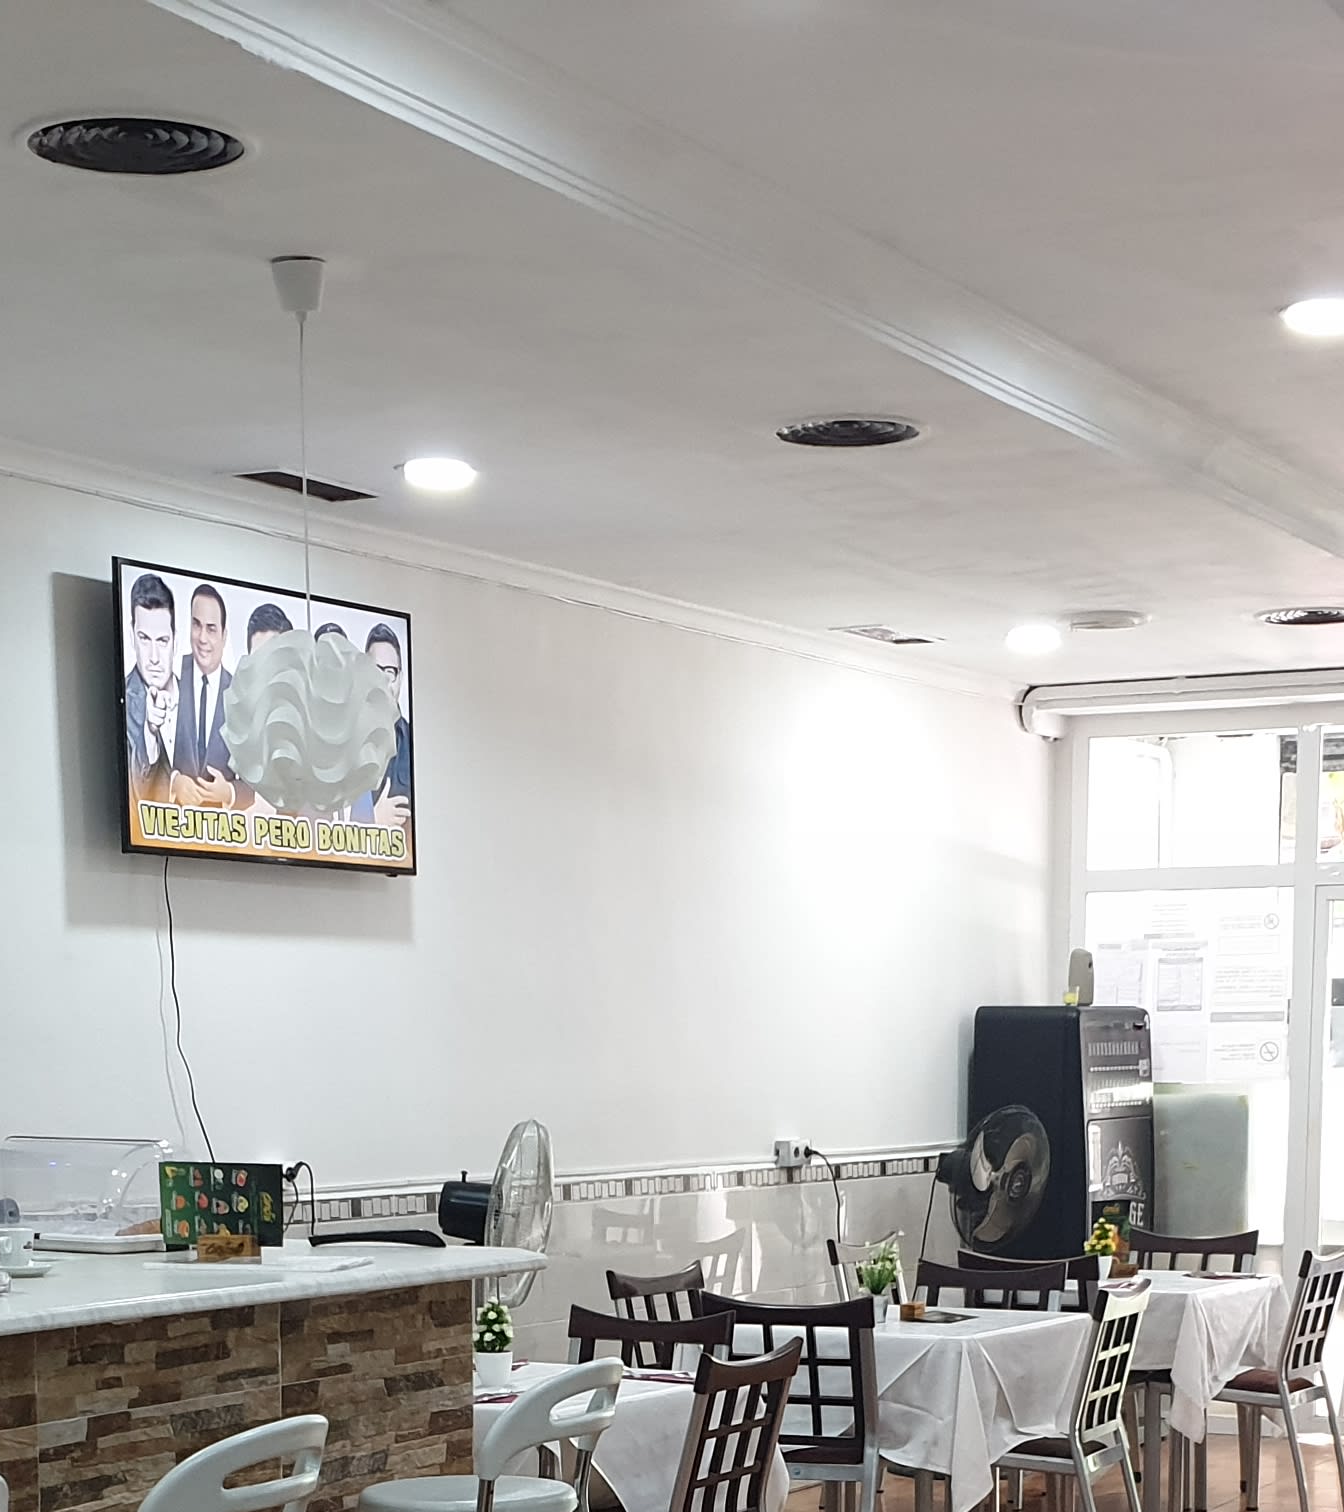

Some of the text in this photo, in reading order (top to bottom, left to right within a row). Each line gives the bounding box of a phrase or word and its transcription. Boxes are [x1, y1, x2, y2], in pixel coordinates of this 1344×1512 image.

[140, 805, 406, 857] VIEJITAS PERO BONITAS
